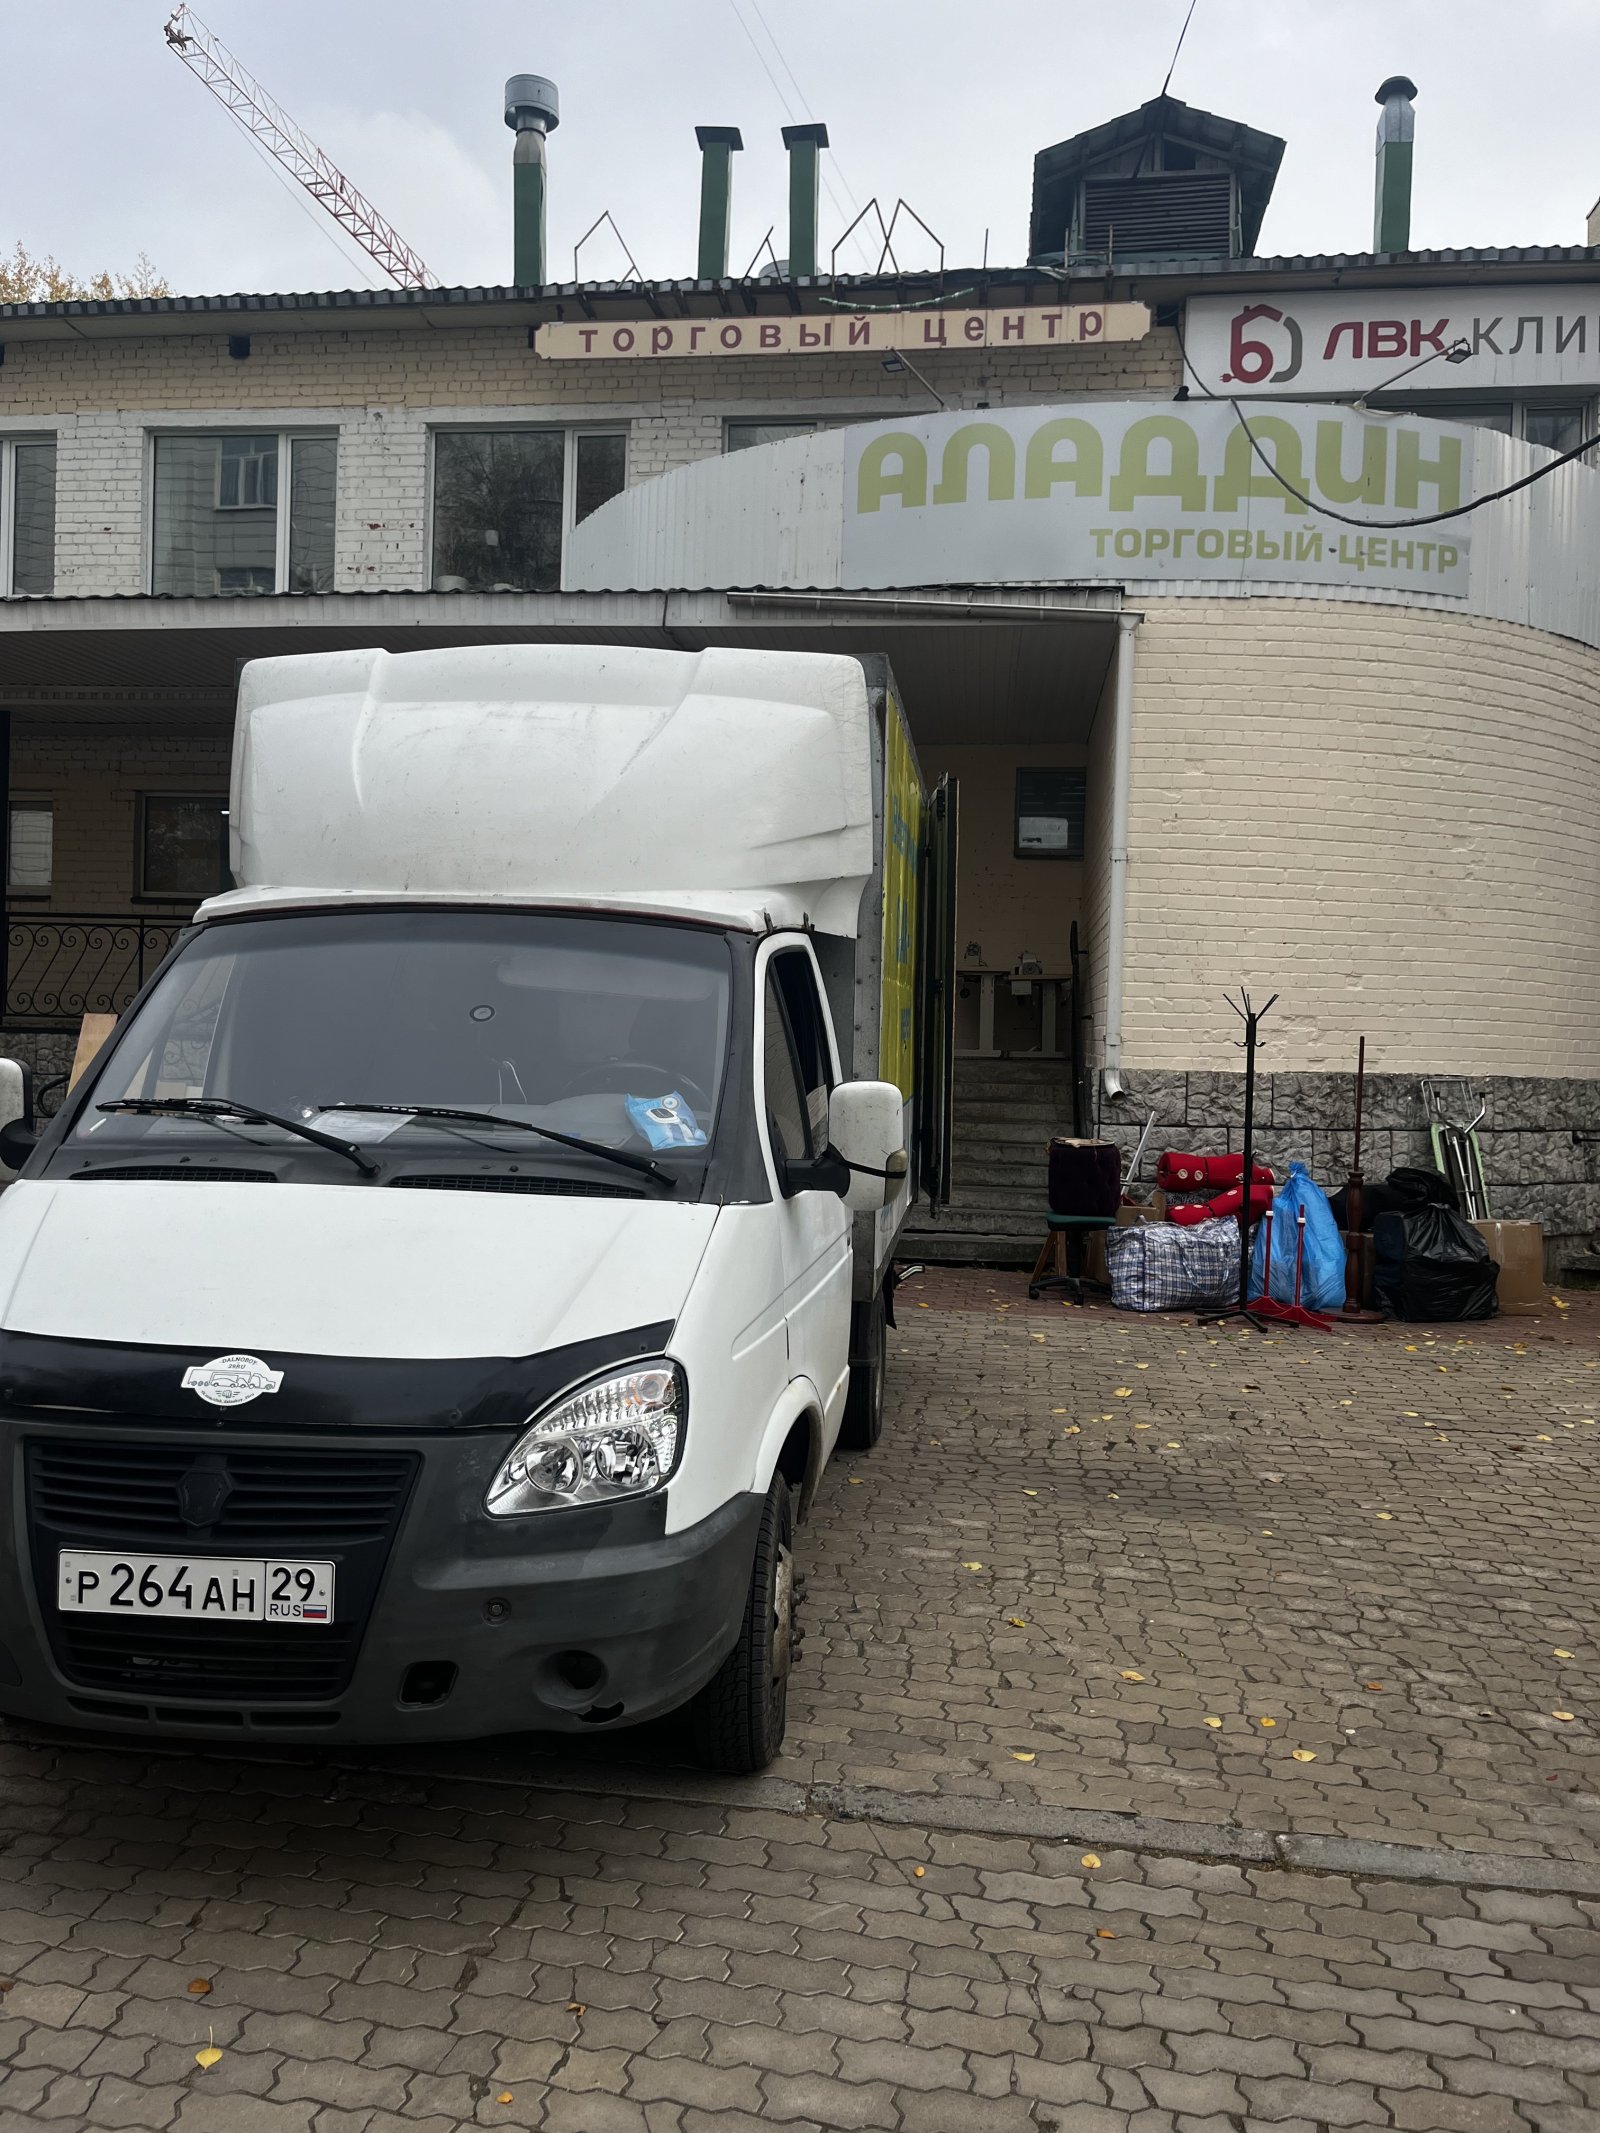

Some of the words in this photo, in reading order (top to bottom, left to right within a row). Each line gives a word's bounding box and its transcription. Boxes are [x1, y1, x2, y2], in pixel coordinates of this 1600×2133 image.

[578, 315, 872, 355] торговый
[923, 310, 1103, 347] центр
[1322, 317, 1450, 360] ЛВК
[1472, 315, 1600, 355] КЛИ
[857, 414, 1462, 515] АЛАДДИН
[1089, 524, 1324, 562] ТОРГОВЫЙ
[1338, 533, 1459, 574] ЦЕНТР
[271, 1566, 316, 1602] 29
[269, 1603, 301, 1617] RUS
